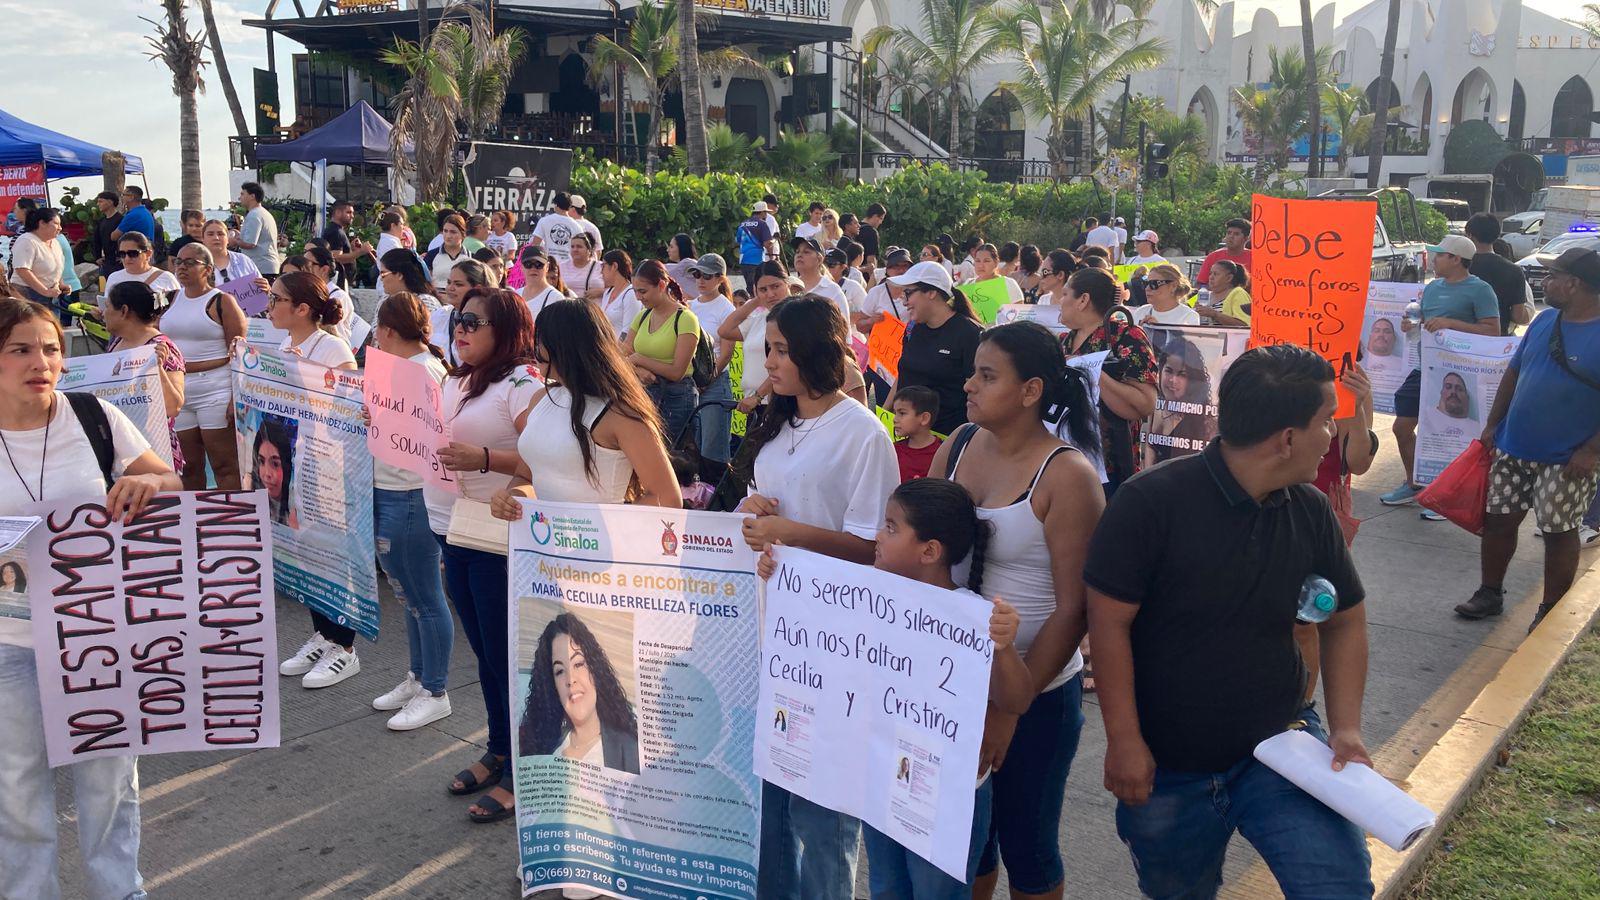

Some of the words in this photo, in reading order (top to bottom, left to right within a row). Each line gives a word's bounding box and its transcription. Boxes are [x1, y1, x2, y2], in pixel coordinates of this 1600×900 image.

[7, 182, 45, 196] defender
[475, 186, 556, 211] TERRAZA
[1253, 203, 1344, 260] Bebe
[260, 362, 287, 377] Sinaloa
[1454, 364, 1479, 373] ANTONIO
[121, 395, 152, 407] FLORES
[299, 394, 305, 404] a
[1155, 399, 1166, 410] OY
[1167, 400, 1203, 415] MARCHO
[1205, 404, 1218, 417] PO
[298, 409, 341, 430] HERNÁNDEZ
[341, 422, 368, 437] OSUNA
[1148, 432, 1193, 450] QUEREMOS
[1192, 438, 1204, 451] DE
[195, 490, 264, 628] CRISTINA
[554, 532, 599, 550] Sinaloa
[682, 534, 733, 547] SINALOA
[121, 495, 187, 625] FALTAN
[539, 559, 611, 586] Ayúdanos
[616, 572, 627, 586] a
[633, 573, 718, 596] encontrar
[724, 582, 736, 597] a
[47, 502, 121, 694] ESTAMOS
[532, 581, 564, 600] MARÍA
[566, 588, 608, 607] CECILIA
[611, 594, 687, 615] BERRELLEZA
[689, 602, 739, 619] FLORES
[777, 563, 801, 593] No
[812, 577, 896, 624] seremos
[774, 616, 808, 648] Aún
[816, 630, 850, 657] nos
[856, 633, 912, 676] faltan
[938, 656, 958, 696] 2
[200, 636, 264, 745] CECILIA
[769, 654, 823, 690] Cecilia
[883, 686, 959, 742] Cristina
[68, 708, 130, 755] NO
[522, 831, 531, 842] Si
[536, 829, 570, 839] tienes
[575, 829, 628, 852] información
[632, 847, 676, 864] referente
[692, 860, 715, 871] esta
[523, 844, 549, 856] llama
[620, 855, 631, 867] Tu
[633, 860, 664, 874] ayuda
[666, 867, 678, 877] es
[680, 871, 703, 884] muy
[546, 867, 573, 880] (669)
[575, 868, 591, 879] 327
[592, 872, 612, 885] 8424
